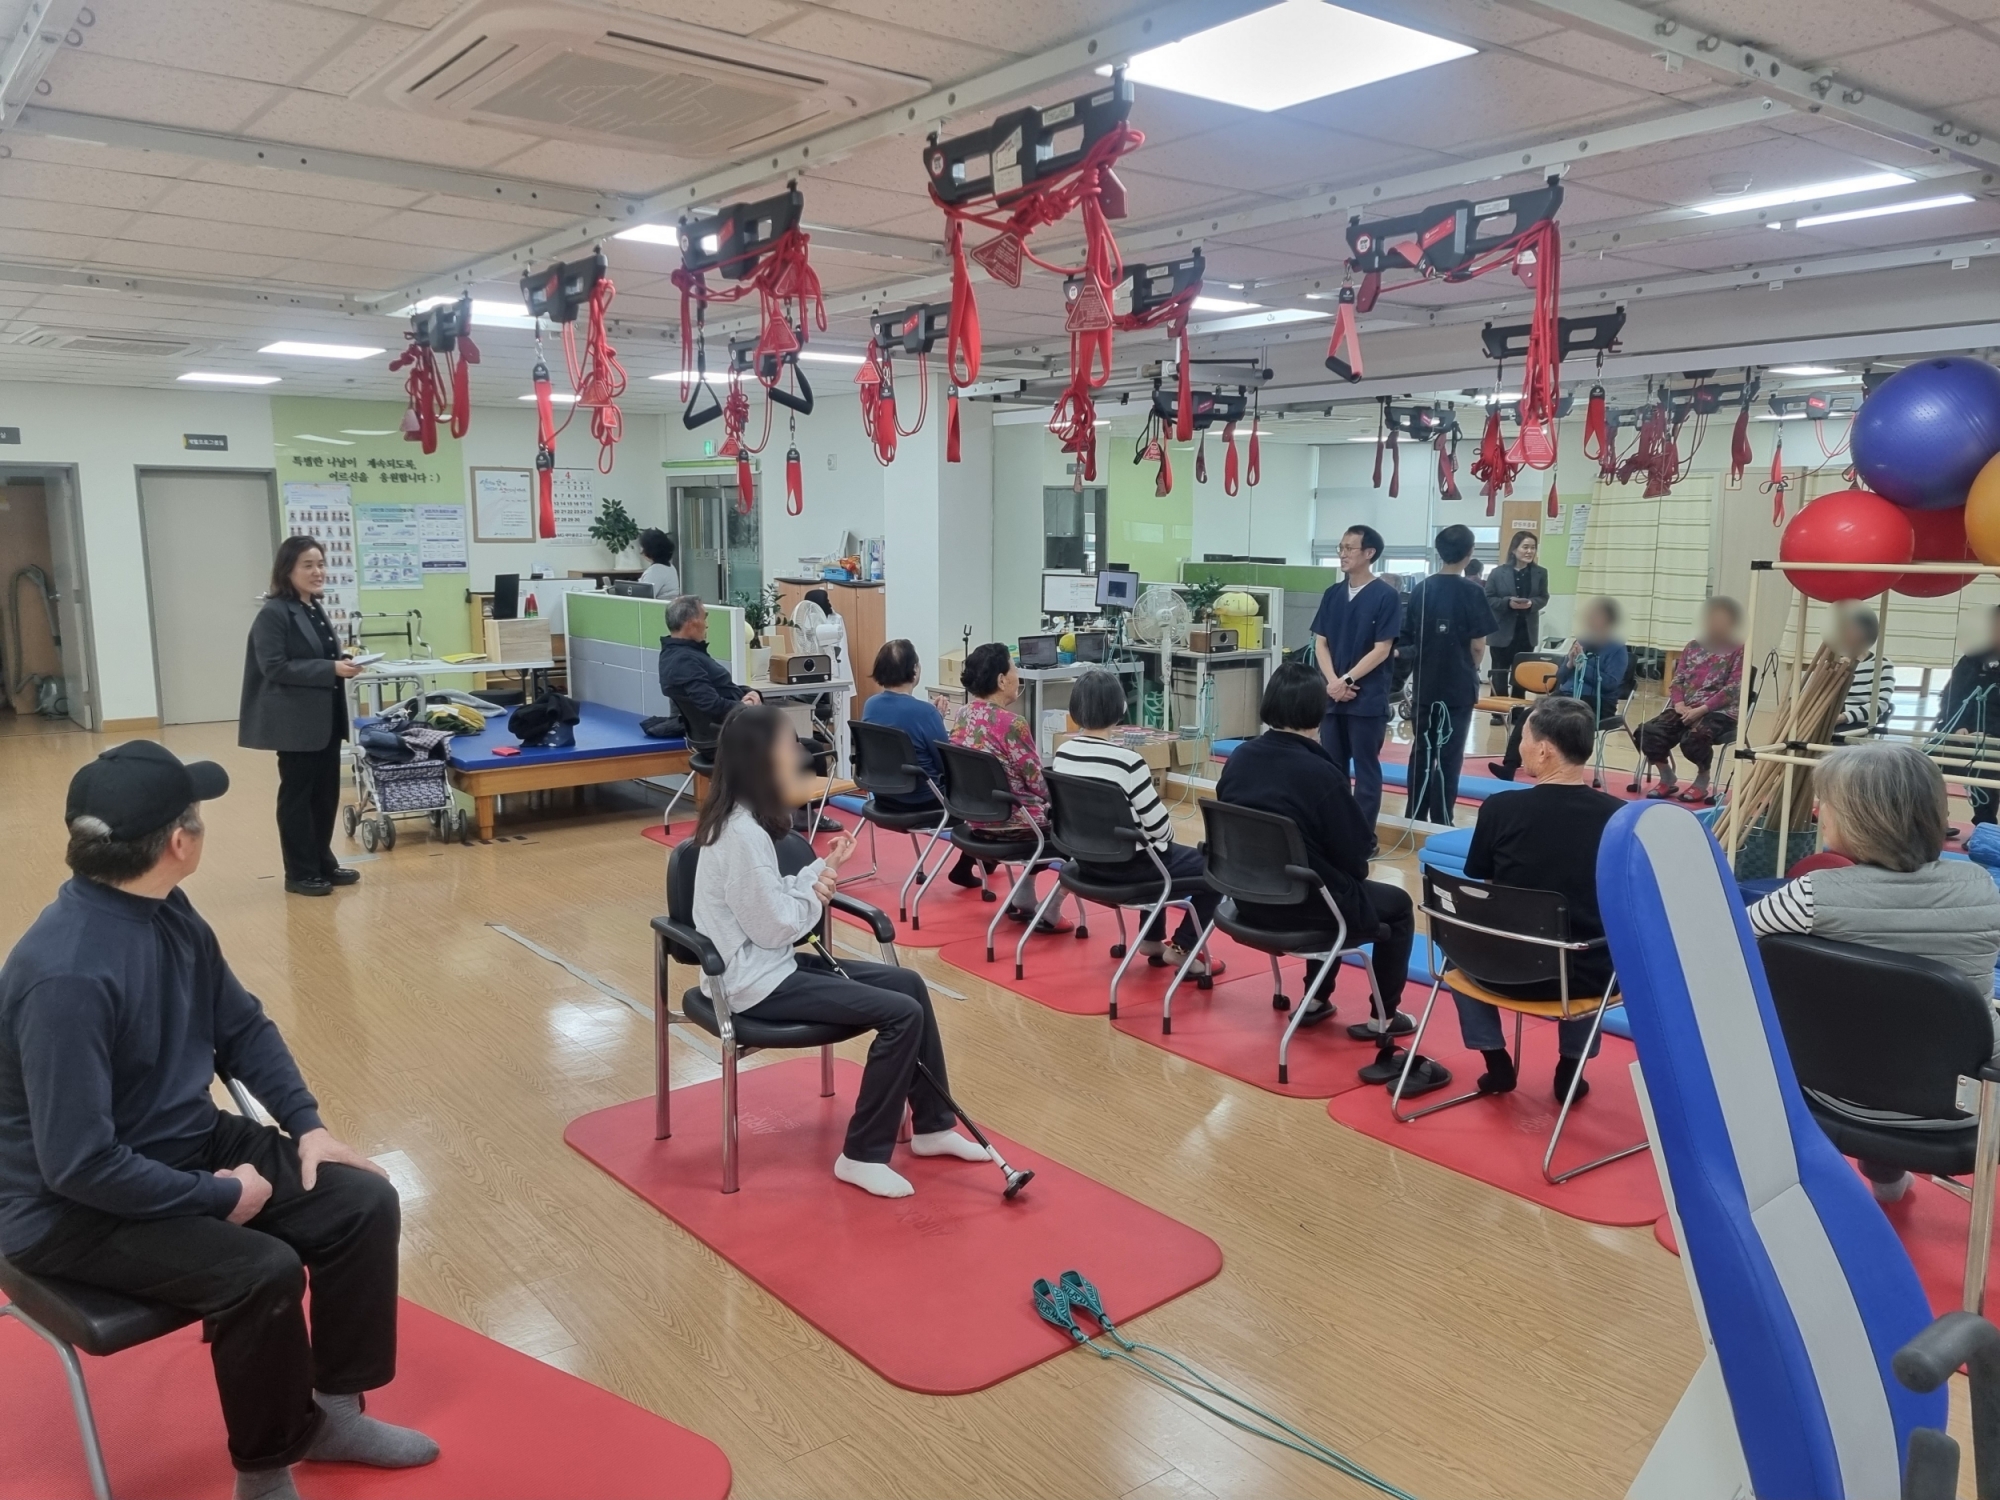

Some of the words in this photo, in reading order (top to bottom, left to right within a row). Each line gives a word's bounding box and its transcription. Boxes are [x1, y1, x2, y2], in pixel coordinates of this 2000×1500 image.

[292, 456, 324, 467] 특별한
[327, 457, 357, 468] 나날이
[329, 471, 369, 483] 어르신을
[379, 472, 427, 483] 응원합니다
[565, 471, 571, 479] 4
